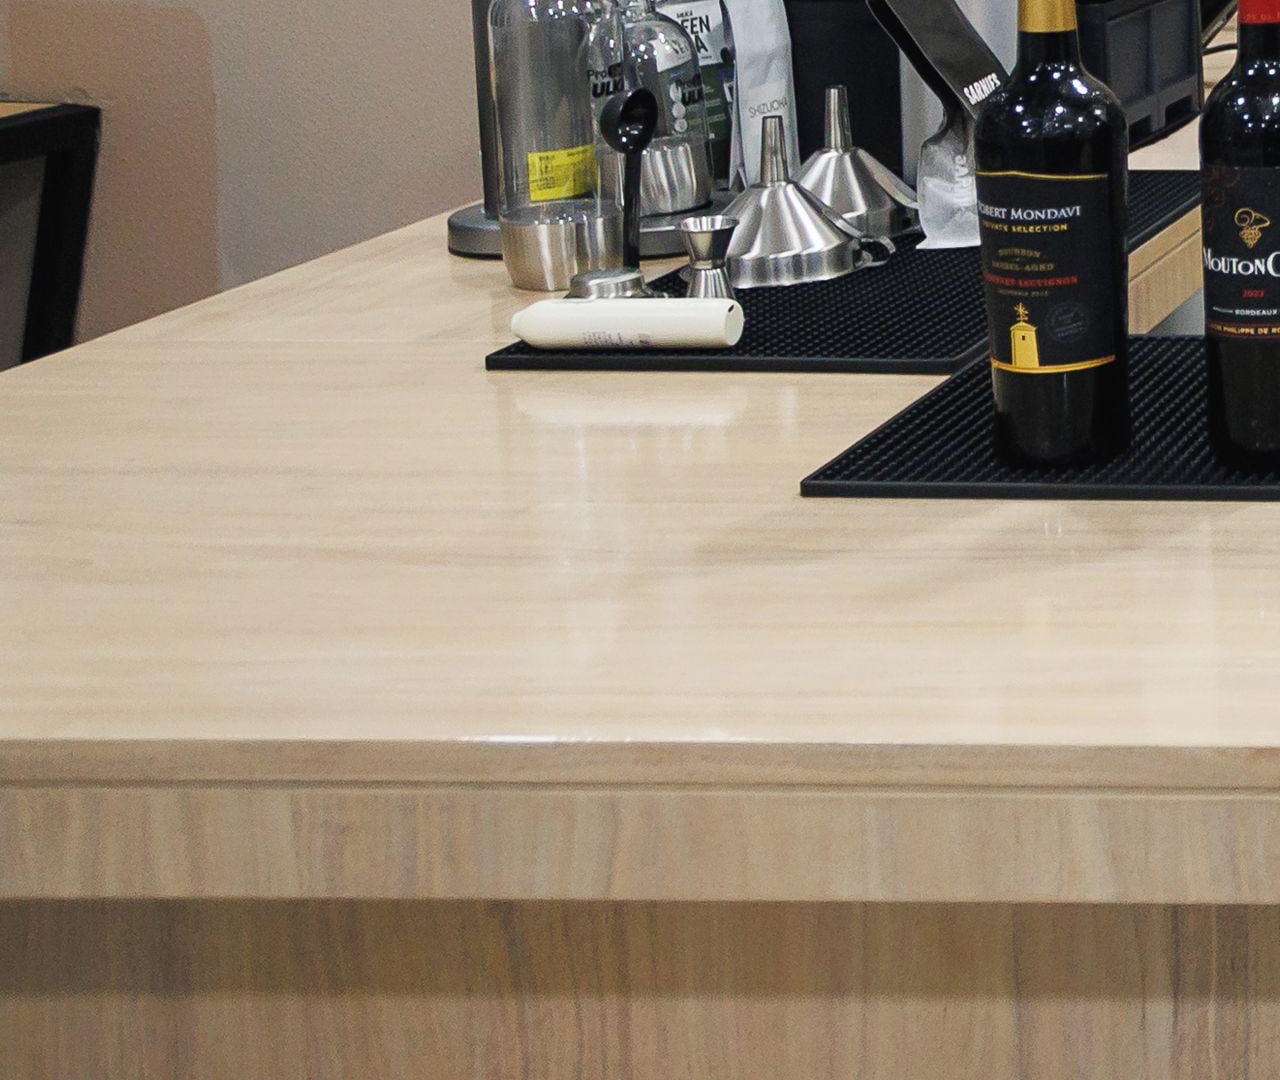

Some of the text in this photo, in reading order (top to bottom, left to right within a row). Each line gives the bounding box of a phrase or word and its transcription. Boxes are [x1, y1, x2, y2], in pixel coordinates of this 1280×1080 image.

[963, 73, 1001, 105] SARNIES
[1010, 206, 1081, 220] MONDAVI
[1011, 224, 1068, 233] SELECTION
[1235, 309, 1278, 317] BORDEAUX
[1223, 326, 1255, 335] PHILIPPE
